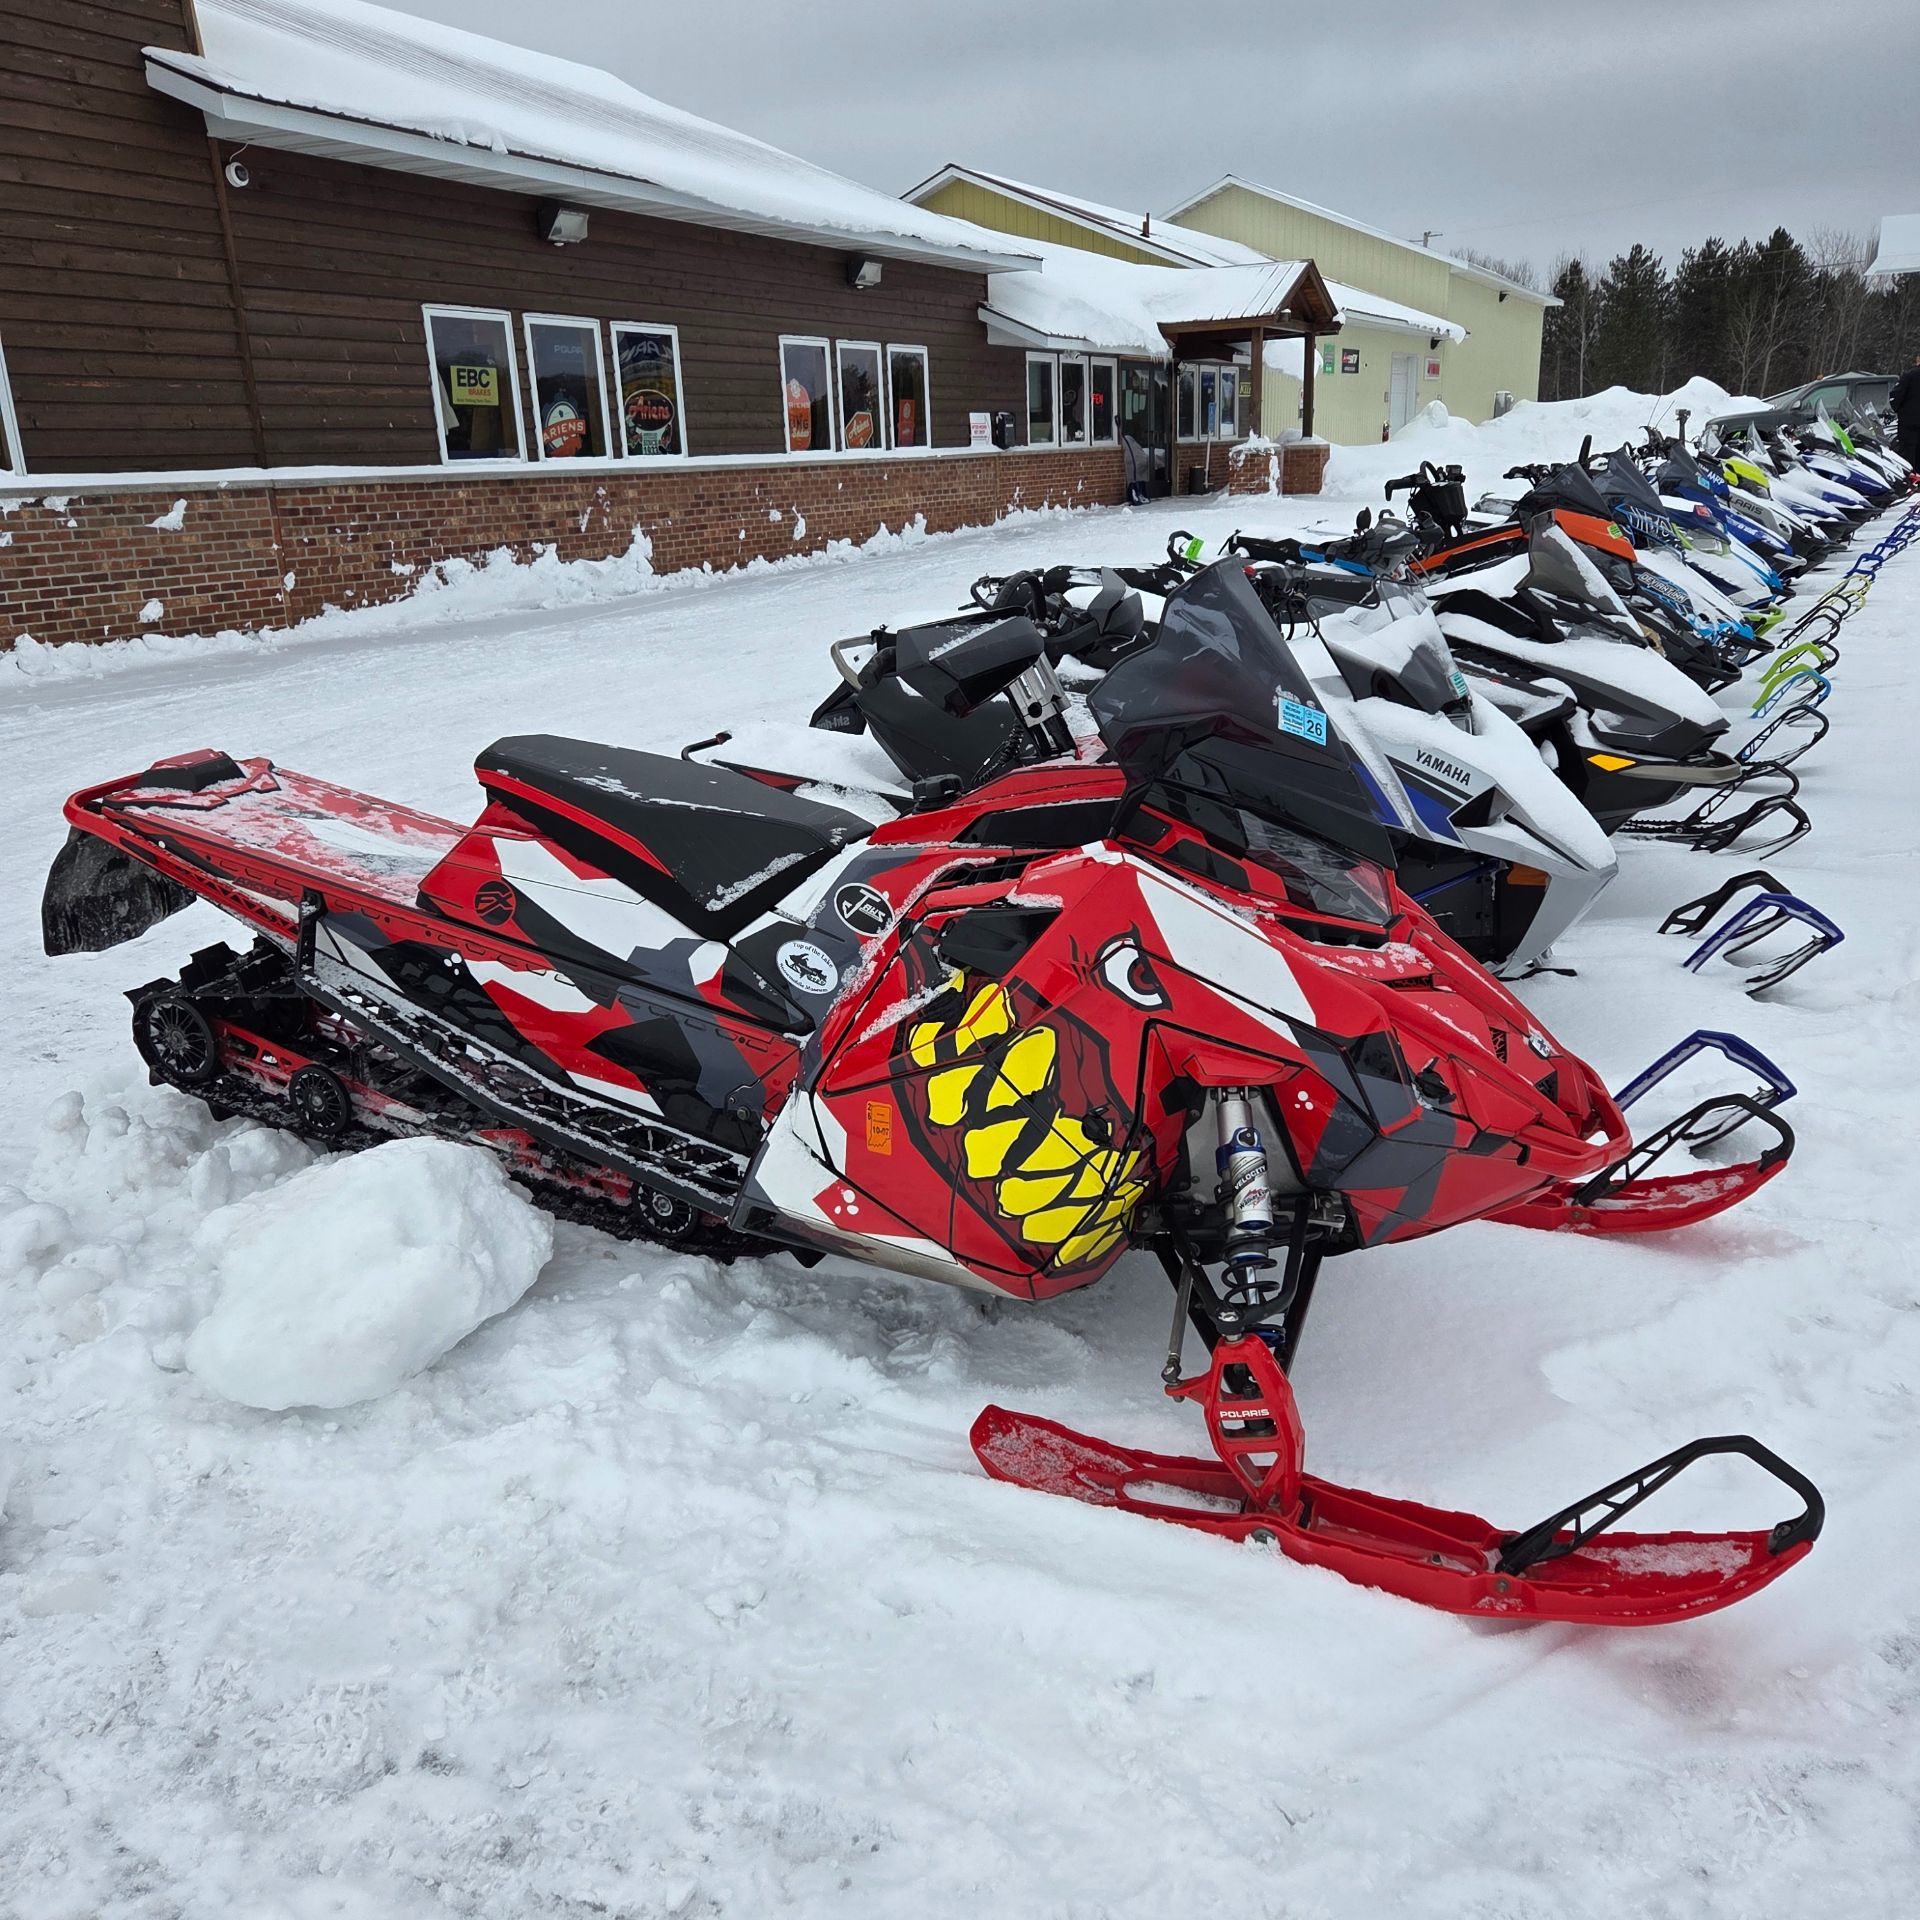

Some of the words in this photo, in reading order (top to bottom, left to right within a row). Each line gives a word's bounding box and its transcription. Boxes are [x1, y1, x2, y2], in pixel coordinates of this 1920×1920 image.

[456, 368, 490, 388] EBC
[543, 422, 584, 441] ARIENS
[1730, 497, 1763, 514] LARIS
[1306, 719, 1323, 736] 26
[1416, 749, 1471, 785] YAMAHA
[1234, 1165, 1266, 1190] VELOCITY
[1219, 1408, 1270, 1418] POLARIS
